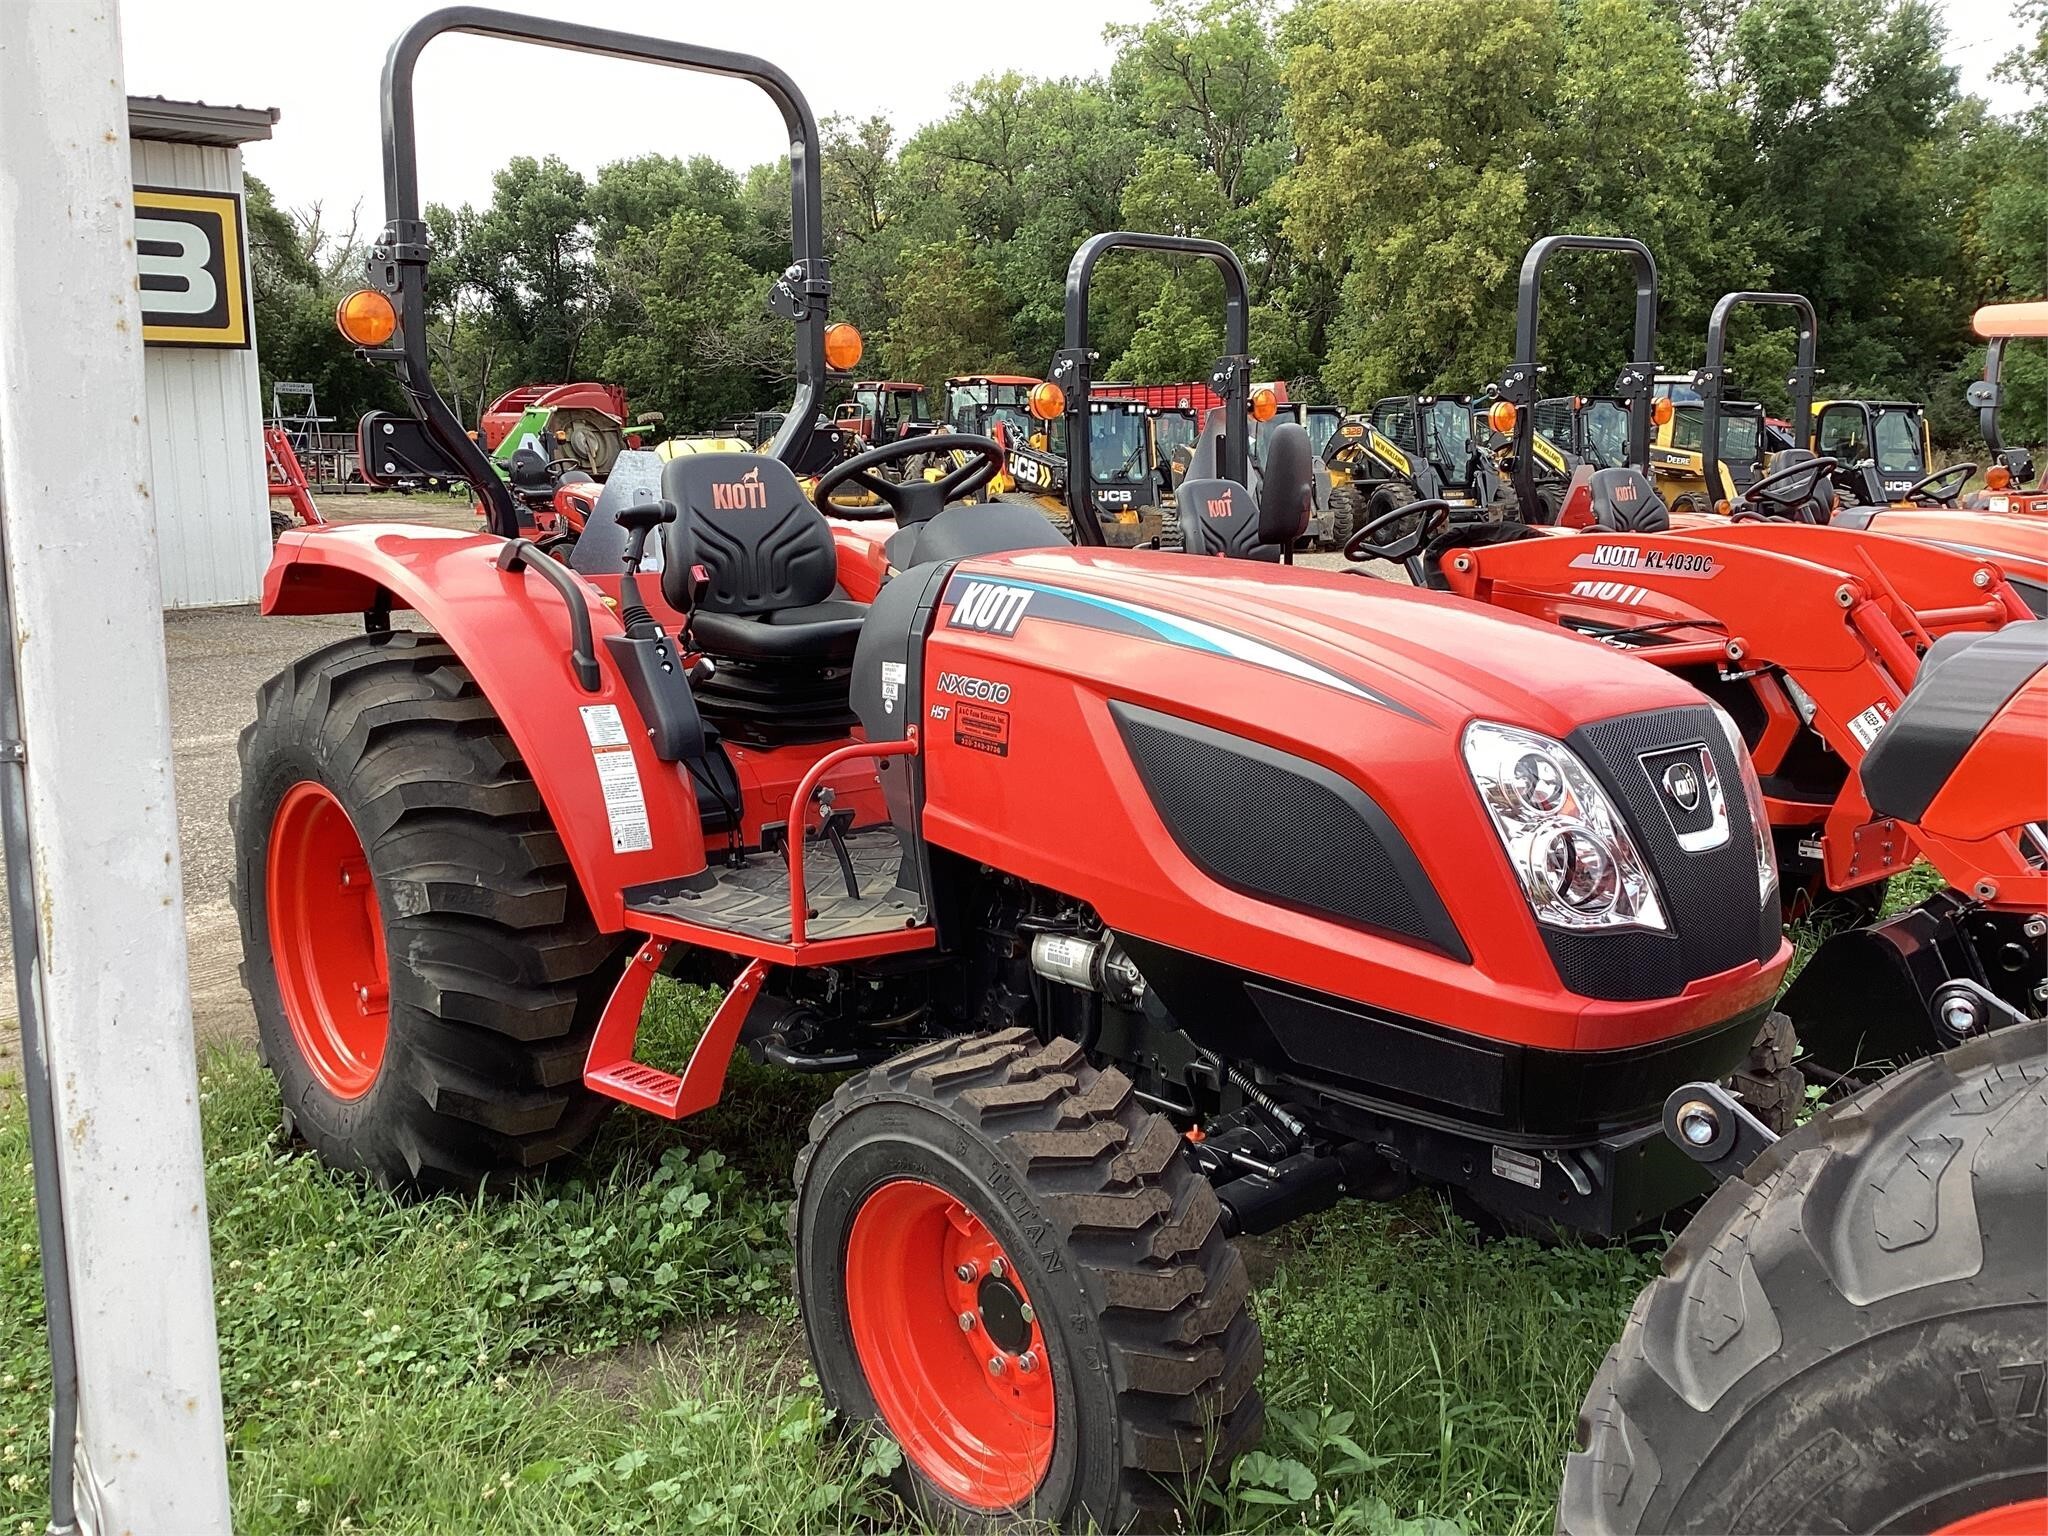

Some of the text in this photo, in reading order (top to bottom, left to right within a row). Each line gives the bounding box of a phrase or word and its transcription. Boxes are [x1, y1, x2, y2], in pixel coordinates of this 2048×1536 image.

[134, 219, 216, 313] B
[1384, 447, 1405, 467] HOLLAND
[1541, 446, 1560, 464] HOLLAND
[1667, 455, 1690, 465] DEERE
[1009, 453, 1038, 483] JCB
[712, 482, 766, 510] KIOTI
[1098, 490, 1132, 501] JCB
[1884, 481, 1912, 491] JCB
[1592, 544, 1715, 573] KIOTI KL4030C
[951, 581, 1035, 633] KIOTI
[937, 672, 1011, 704] NX6010
[930, 704, 950, 720] HST
[1862, 709, 1879, 727] KEEP
[986, 1160, 1068, 1274] TITAN
